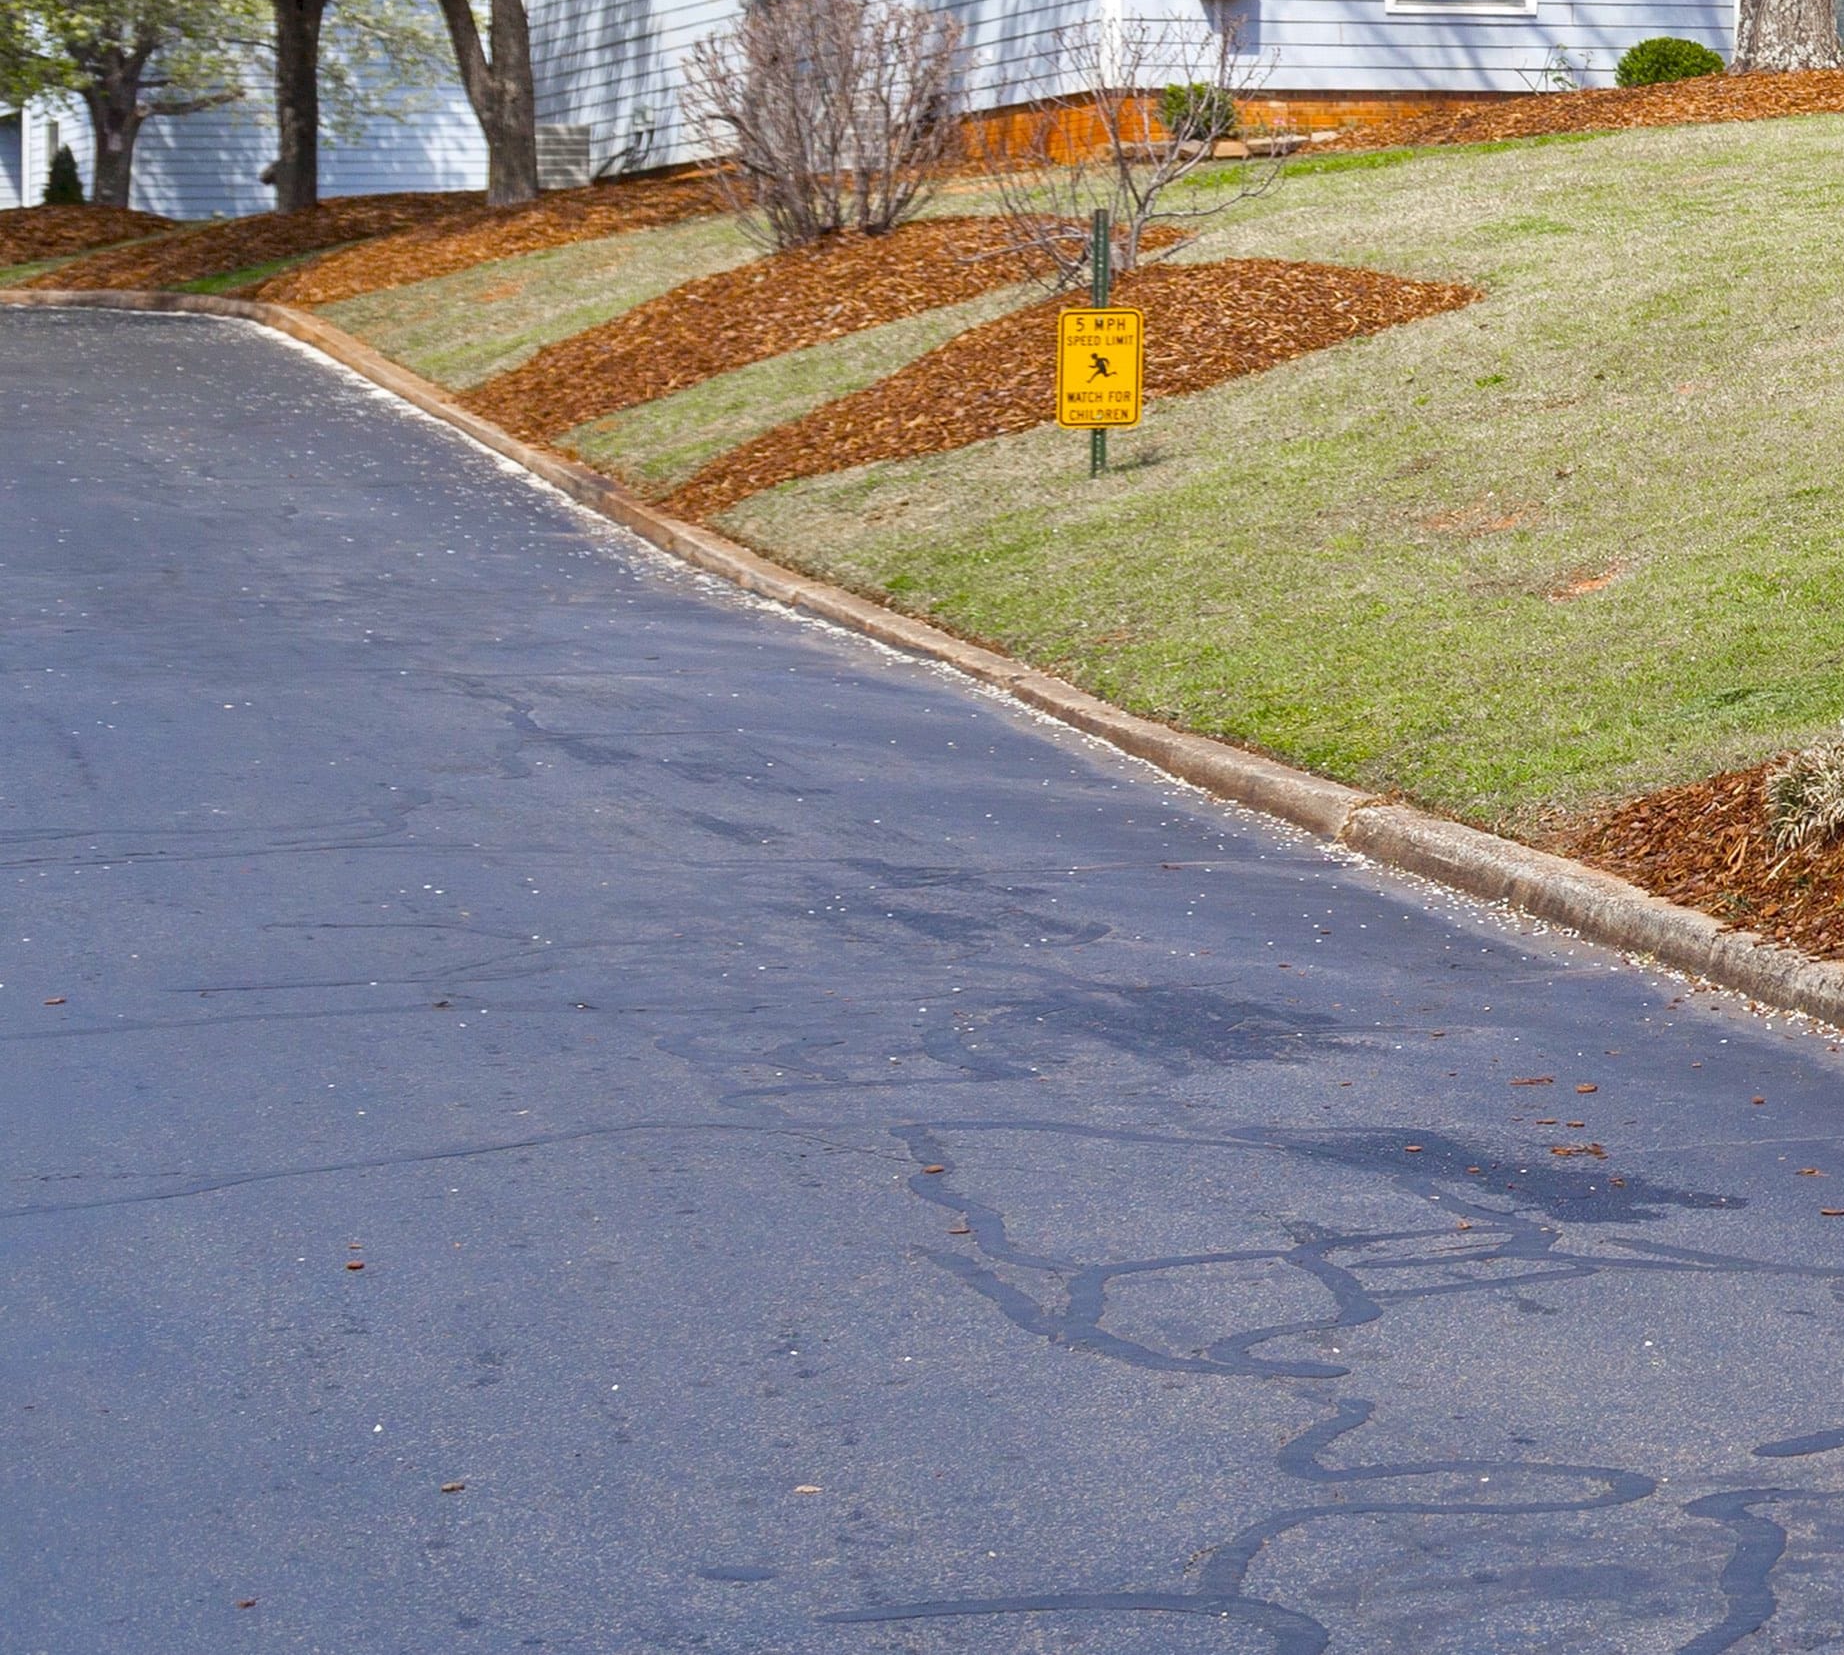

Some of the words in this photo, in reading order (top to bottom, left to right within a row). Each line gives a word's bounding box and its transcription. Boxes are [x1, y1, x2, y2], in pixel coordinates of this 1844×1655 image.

[1076, 317, 1085, 332] 5
[1094, 317, 1126, 331] MPH
[1066, 335, 1101, 347] SPEED
[1105, 335, 1134, 346] LIMIT
[1066, 391, 1103, 403] WATCH
[1108, 390, 1132, 403] FOR
[1069, 409, 1129, 421] CHILDREN
